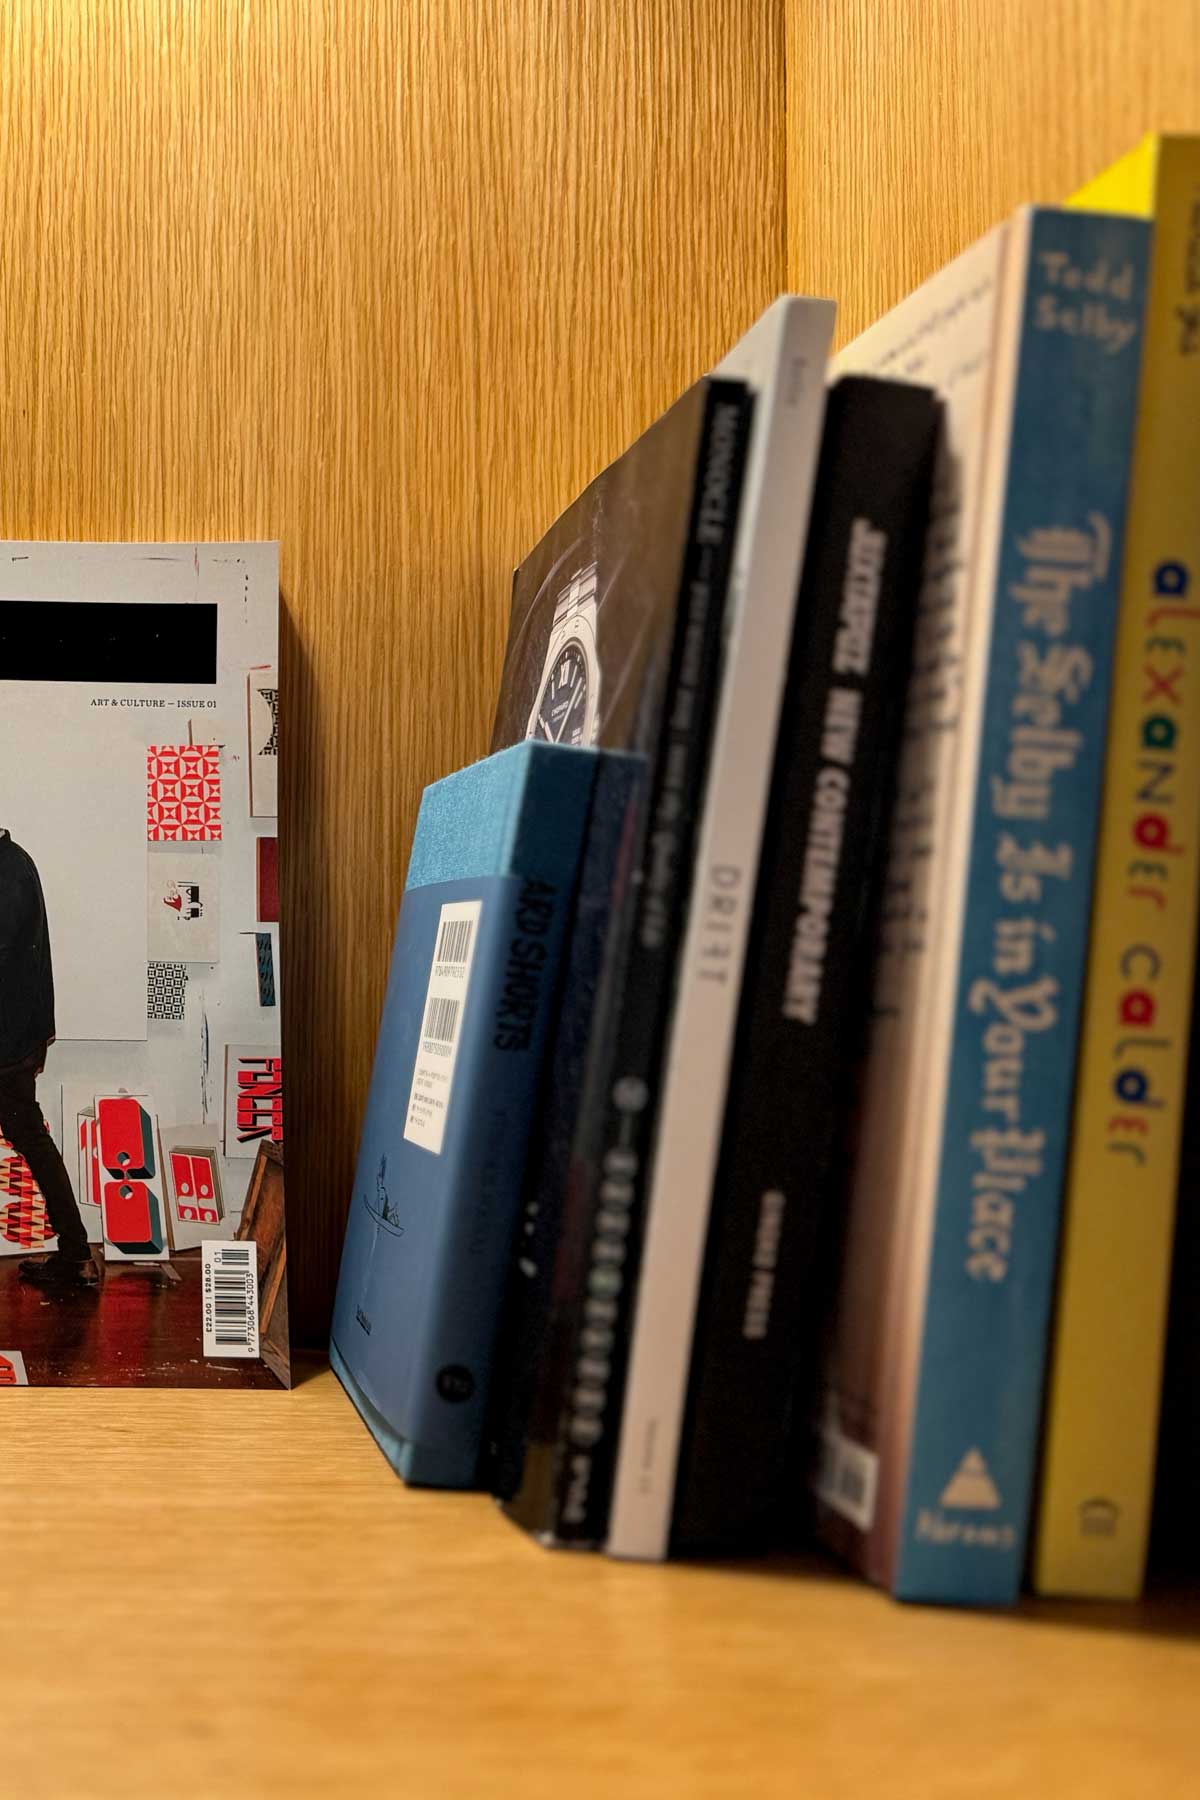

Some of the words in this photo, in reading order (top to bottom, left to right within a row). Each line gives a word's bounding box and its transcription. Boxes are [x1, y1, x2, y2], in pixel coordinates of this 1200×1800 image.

[1010, 513, 1111, 635] The
[90, 699, 109, 707] ART
[111, 699, 118, 707] &
[120, 700, 166, 708] CULTURE
[177, 700, 205, 708] ISSUE
[991, 641, 1093, 820] Selby
[494, 939, 548, 1053] SHORTS
[993, 919, 1054, 973] in
[968, 977, 1059, 1121] Your
[965, 1127, 1046, 1283] Place
